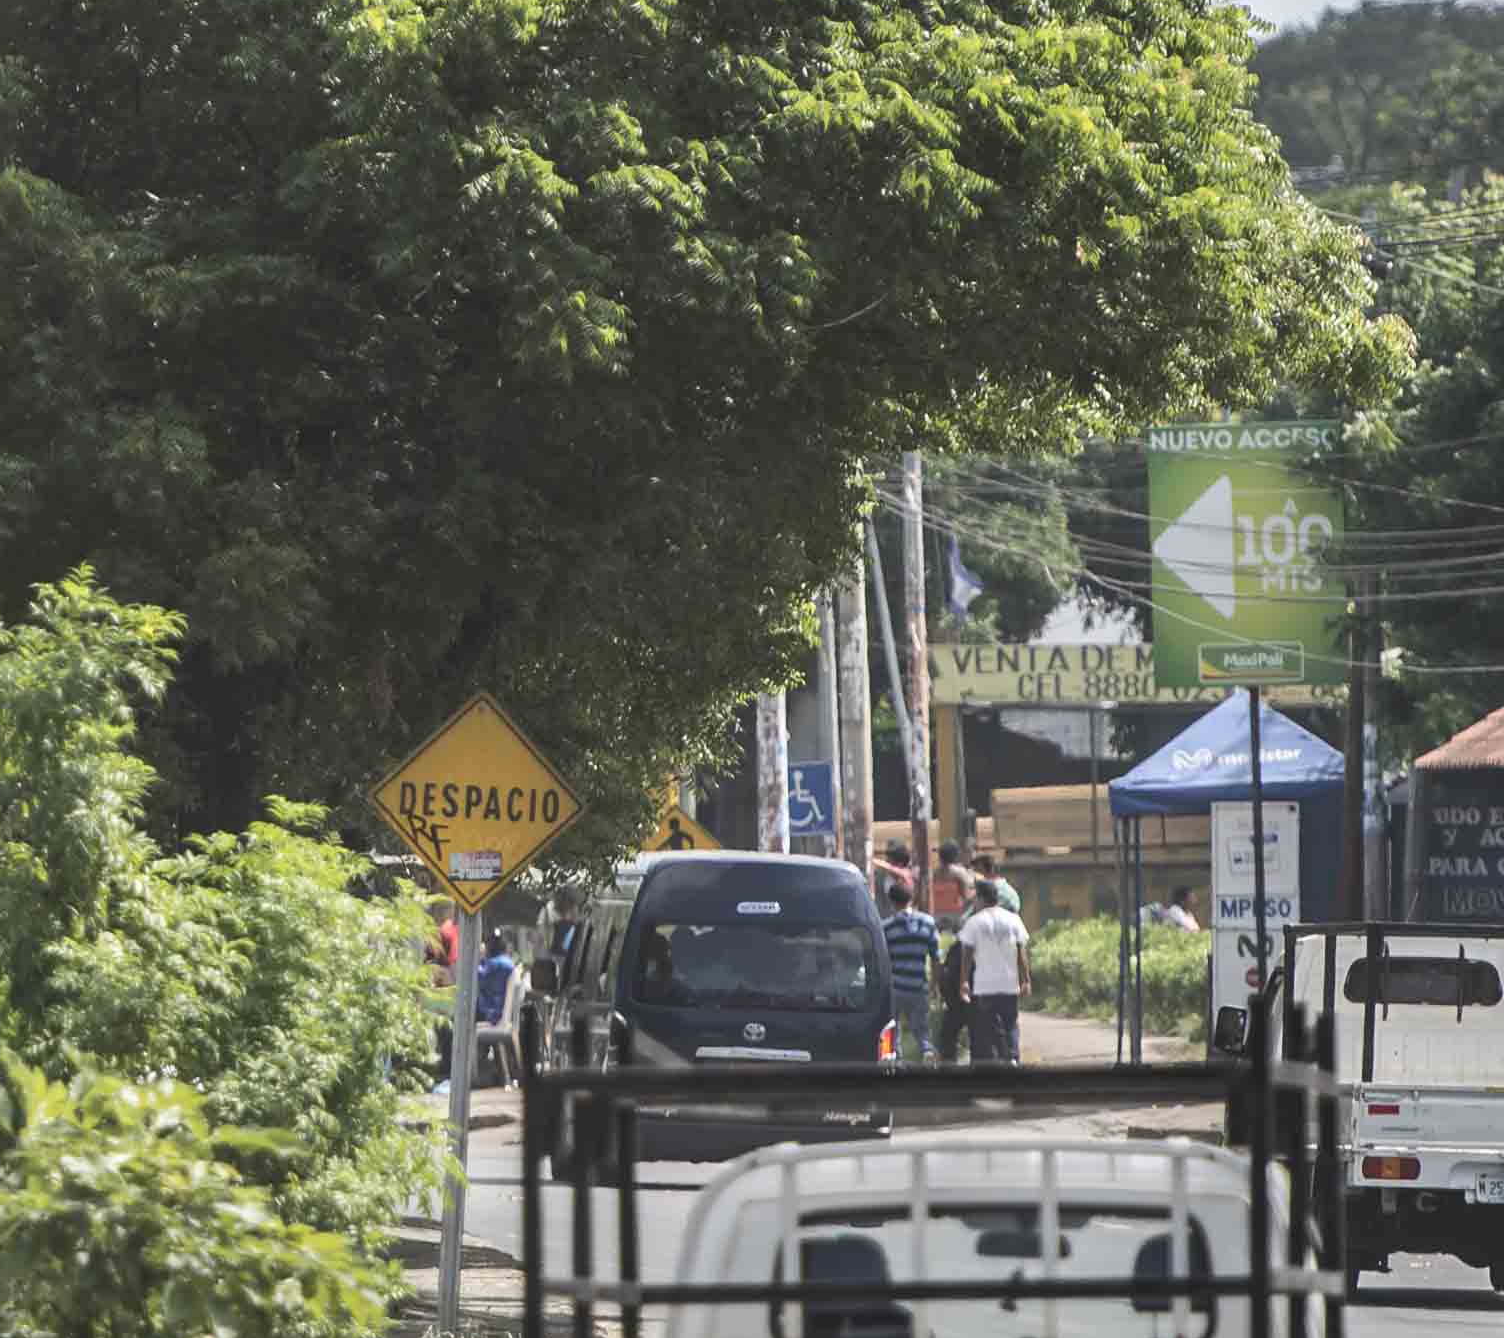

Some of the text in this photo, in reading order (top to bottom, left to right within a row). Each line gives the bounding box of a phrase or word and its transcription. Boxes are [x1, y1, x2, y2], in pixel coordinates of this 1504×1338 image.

[1150, 428, 1233, 451] NUEVO
[952, 644, 1070, 673] VENTA
[1081, 644, 1125, 672] DE
[399, 780, 560, 823] DESPACIO
[1428, 856, 1489, 876] PARA
